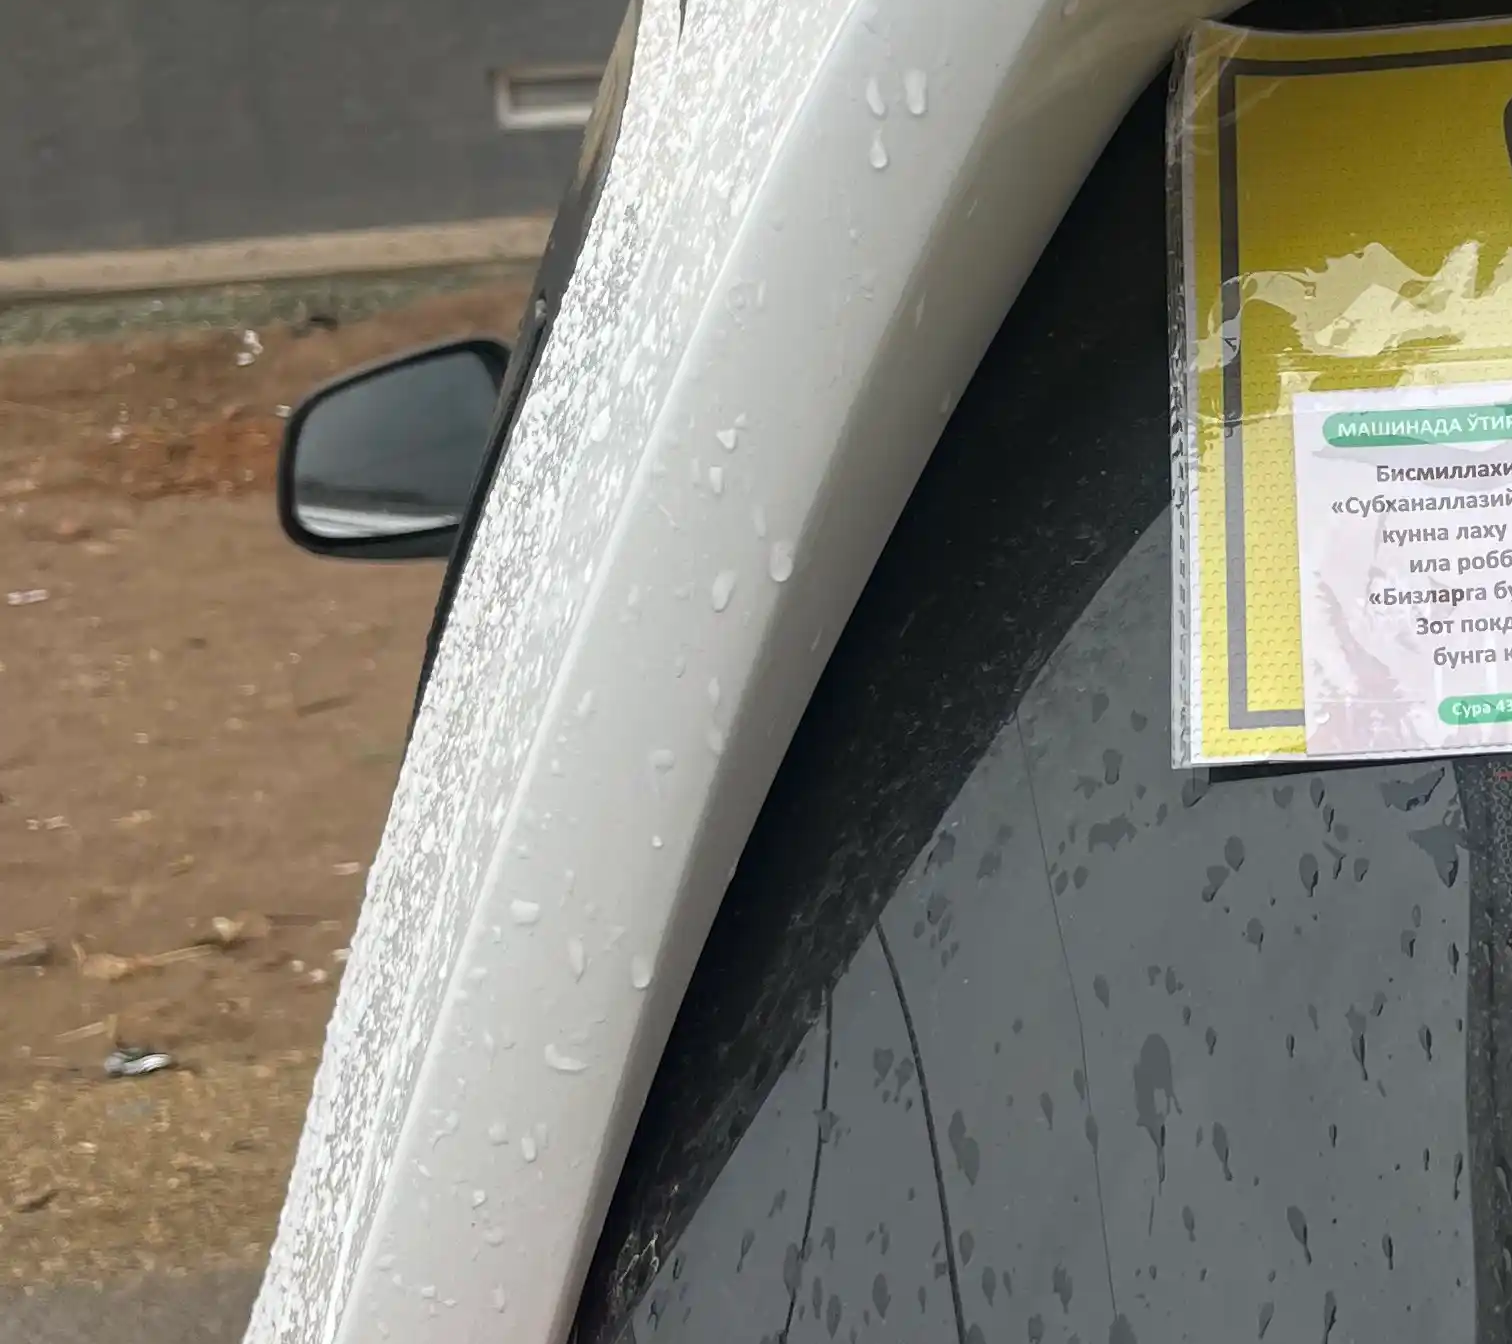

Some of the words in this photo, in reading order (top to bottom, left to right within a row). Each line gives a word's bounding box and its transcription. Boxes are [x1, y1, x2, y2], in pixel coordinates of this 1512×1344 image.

[1337, 417, 1462, 438] МАШИНАДА
[1382, 526, 1449, 547] кунна
[1456, 523, 1507, 543] лаху
[1409, 557, 1450, 573] ила
[1368, 585, 1487, 606] «Бизларга
[1416, 617, 1454, 635] Зот
[1433, 647, 1496, 669] бунга
[1452, 701, 1491, 717] Сура
